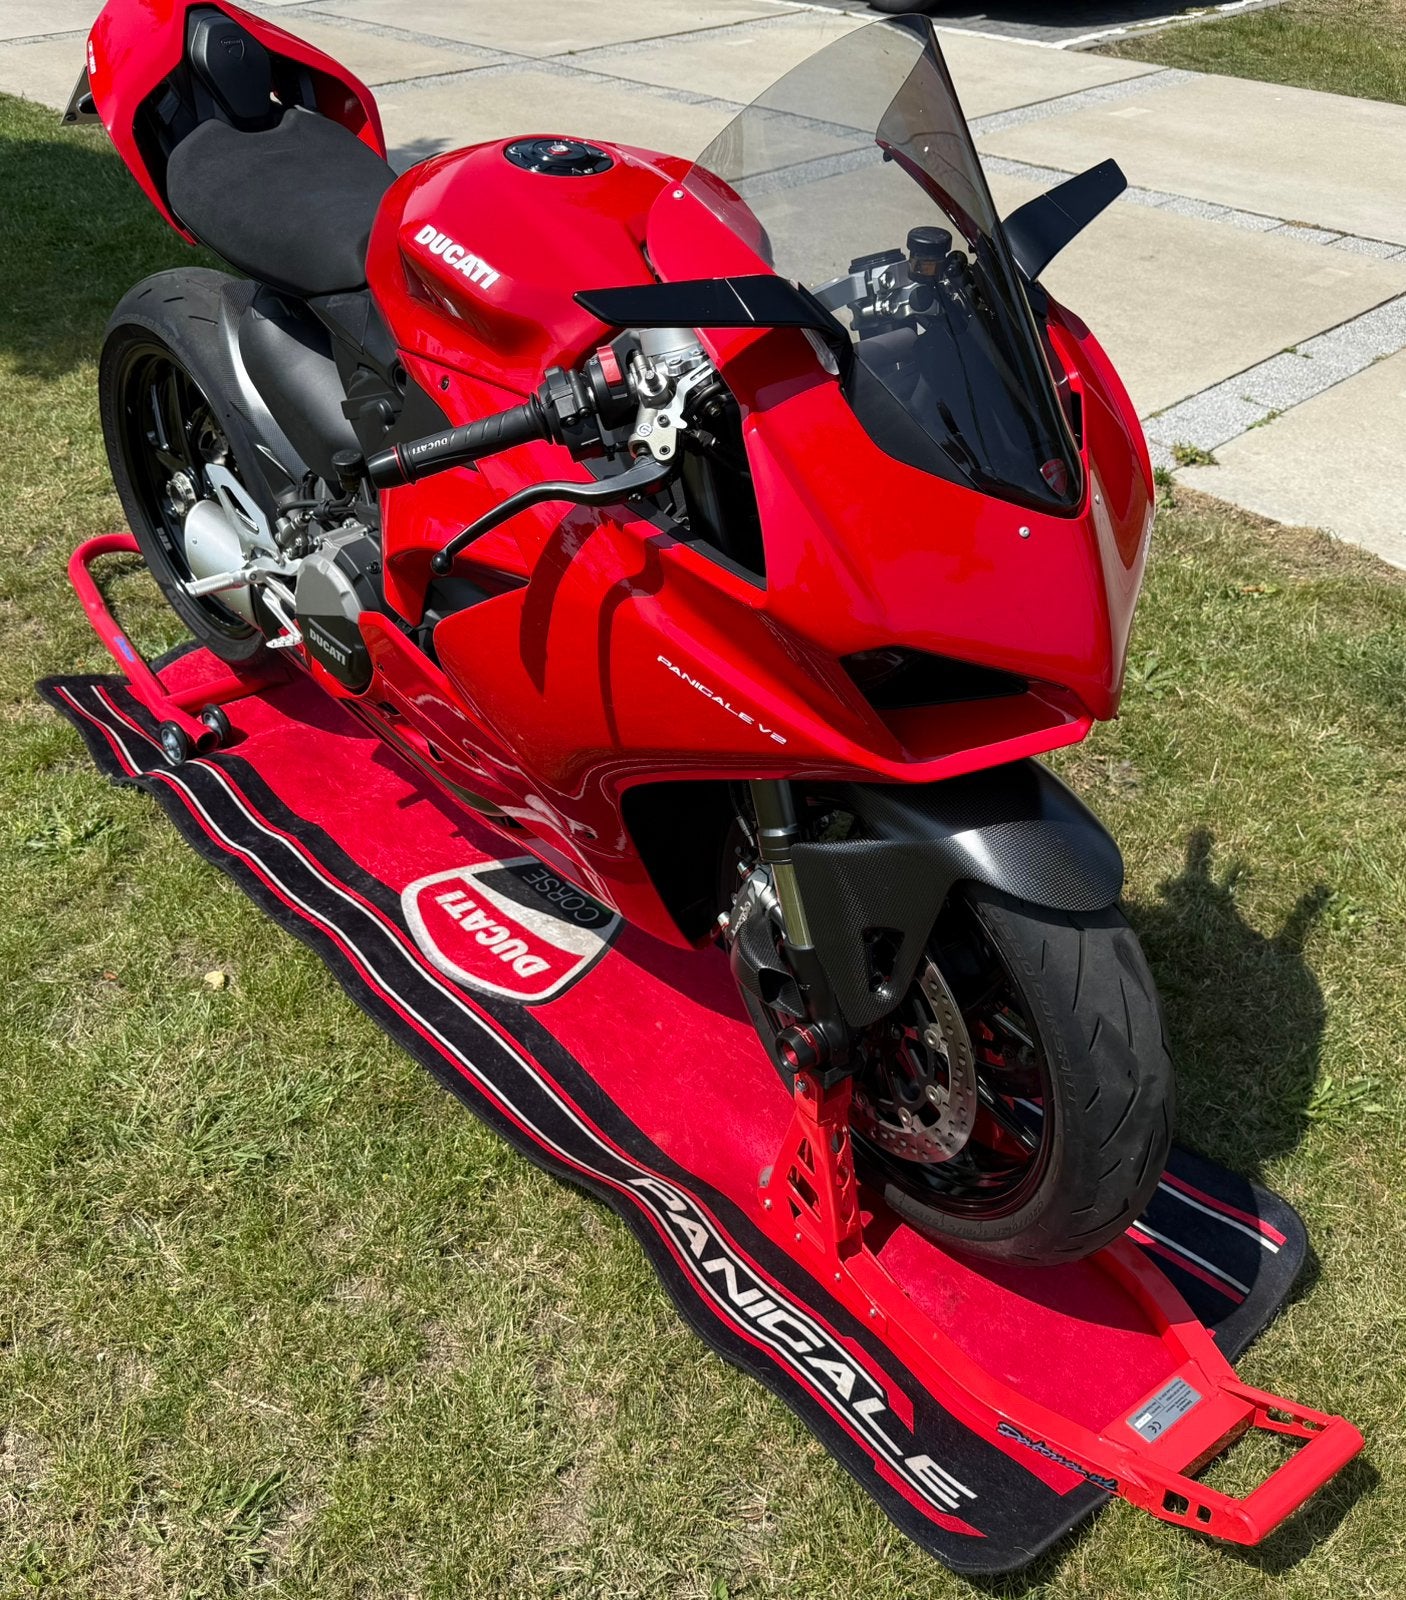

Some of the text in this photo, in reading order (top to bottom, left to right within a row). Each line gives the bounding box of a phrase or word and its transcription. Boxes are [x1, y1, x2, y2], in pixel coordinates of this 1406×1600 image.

[414, 224, 501, 290] DUCATI
[412, 437, 448, 455] DUCATI
[309, 627, 346, 666] DUCATI
[657, 655, 787, 745] PANIGALE V2
[522, 868, 600, 923] CORSE
[434, 890, 552, 979] DUCATI
[627, 1178, 979, 1510] PANIGALE
[1148, 1421, 1162, 1434] CE
